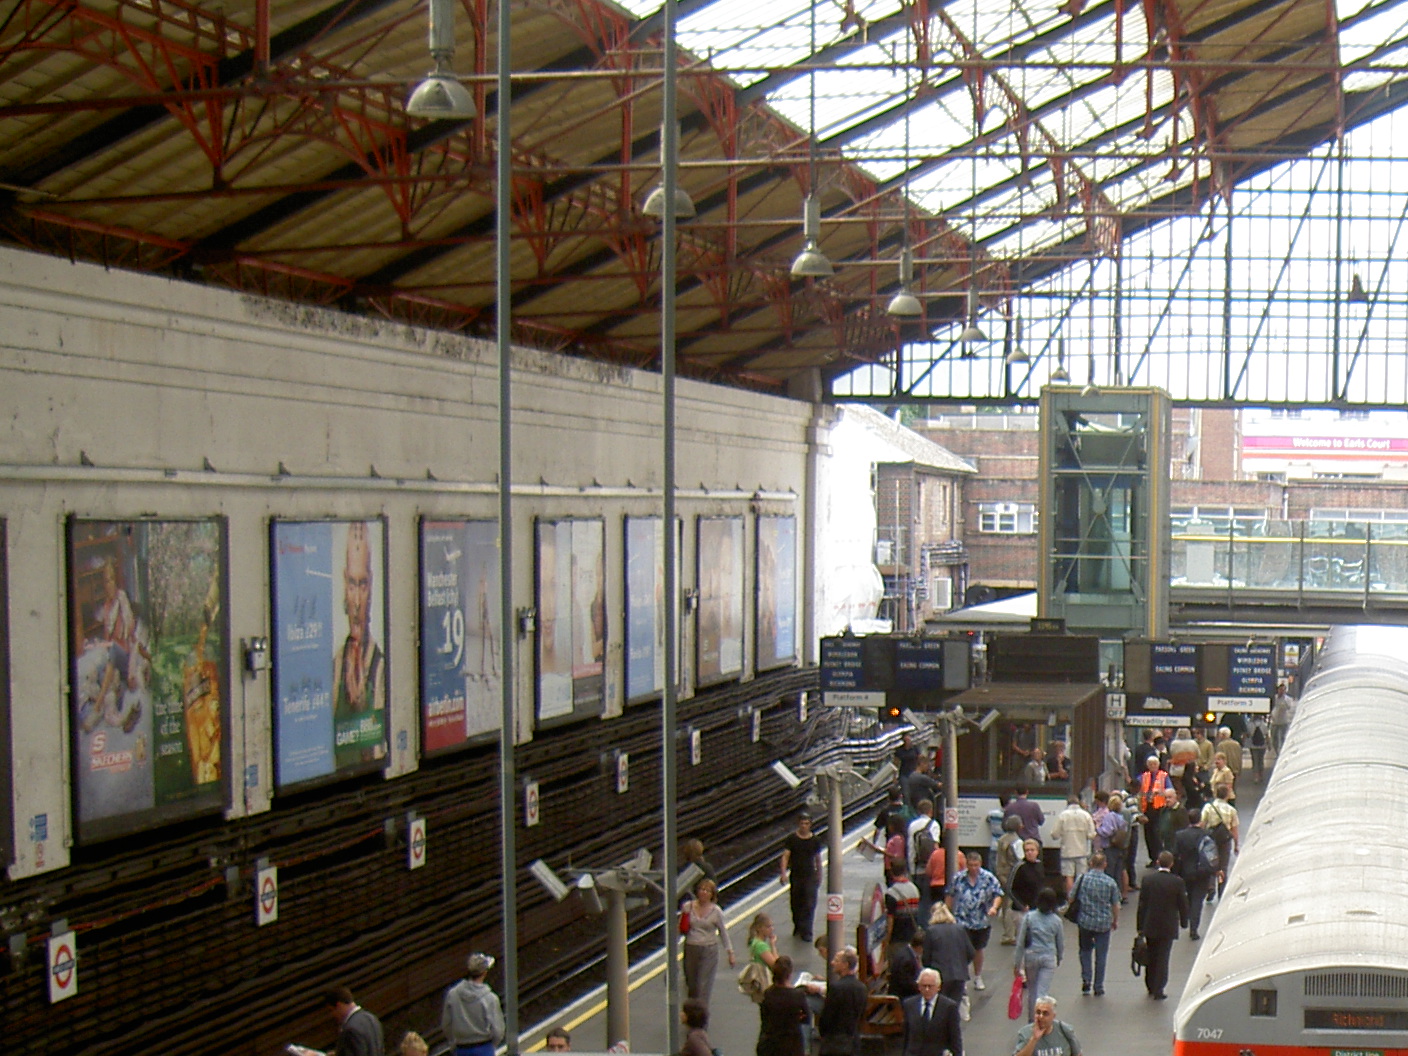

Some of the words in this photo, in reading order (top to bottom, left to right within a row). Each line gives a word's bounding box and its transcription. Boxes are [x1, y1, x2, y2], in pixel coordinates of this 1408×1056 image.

[1293, 437, 1331, 448] Welcome
[1333, 438, 1341, 448] to
[1367, 439, 1390, 449] Court
[1111, 695, 1122, 707] H
[1217, 699, 1247, 707] Platform
[1108, 709, 1124, 717] OFF
[1132, 718, 1165, 726] Piccadilly
[1197, 1028, 1223, 1039] 7047
